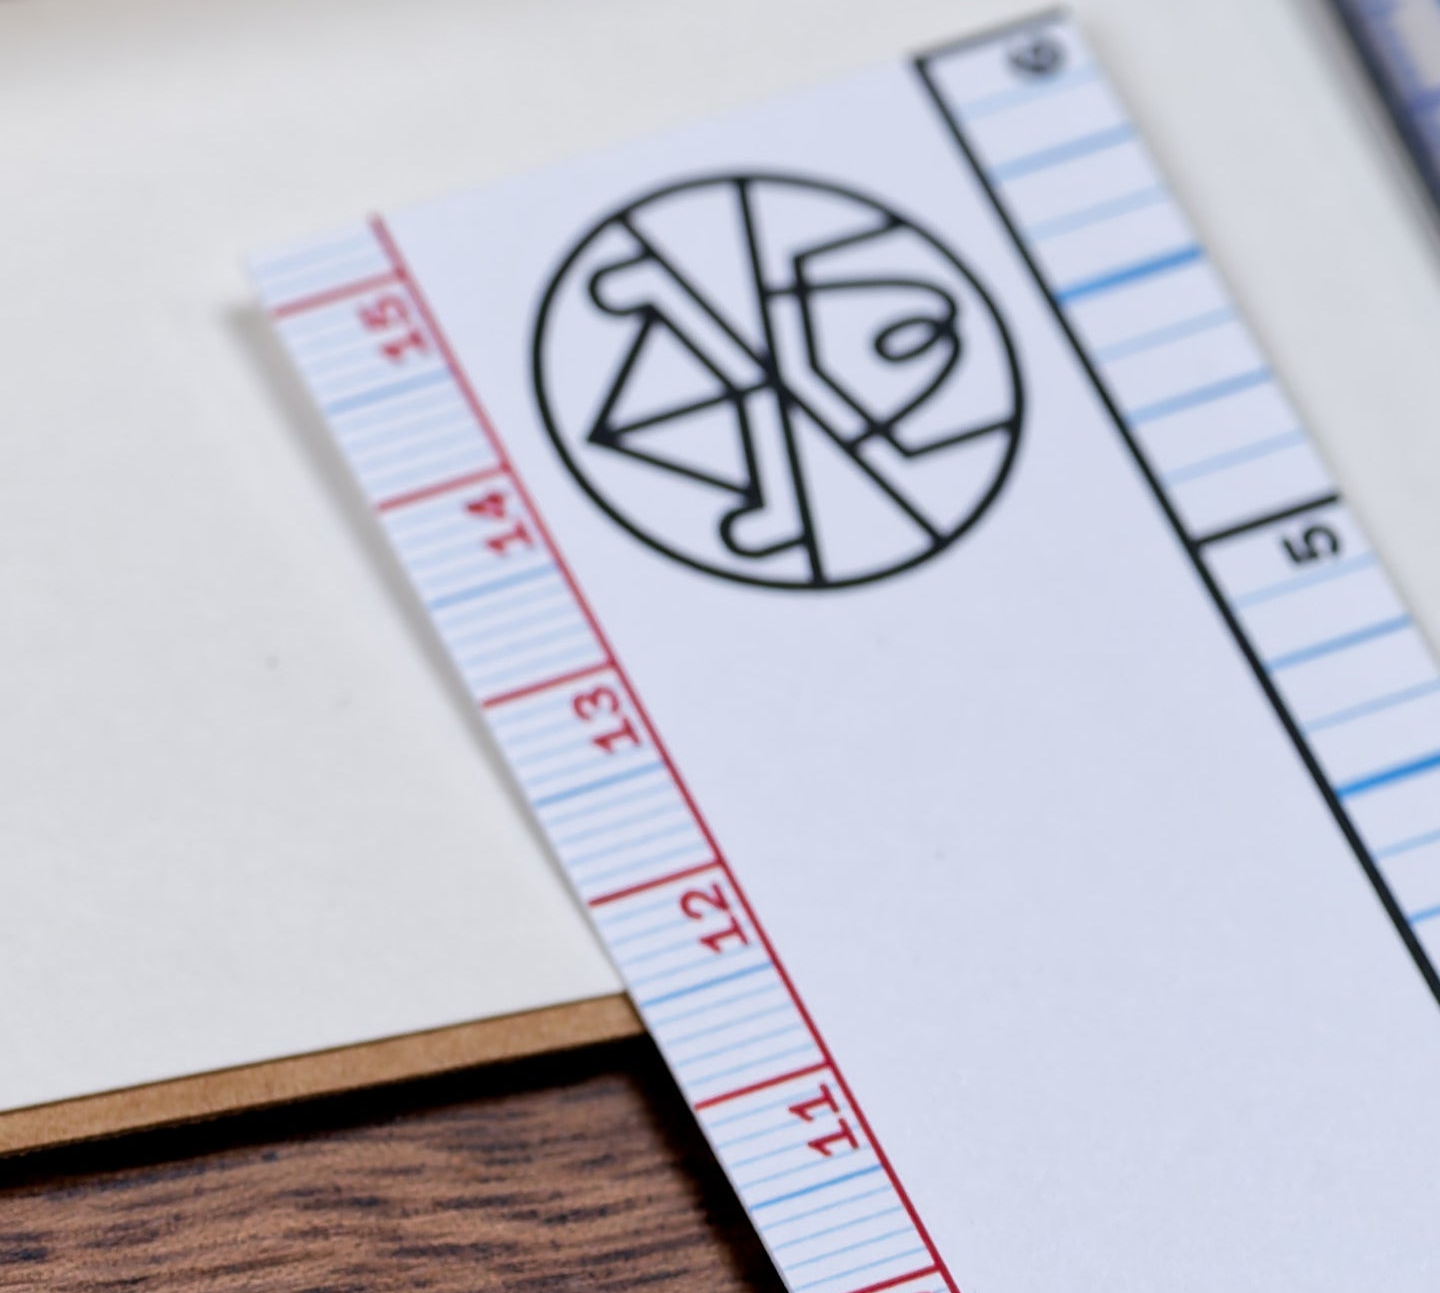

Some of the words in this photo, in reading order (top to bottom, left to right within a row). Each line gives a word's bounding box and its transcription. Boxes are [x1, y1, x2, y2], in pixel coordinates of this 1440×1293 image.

[360, 294, 431, 363] 15
[464, 490, 535, 558] 14
[1283, 526, 1339, 564] 5
[573, 686, 643, 754] 13
[680, 882, 750, 956] 12
[787, 1084, 859, 1156] 11
